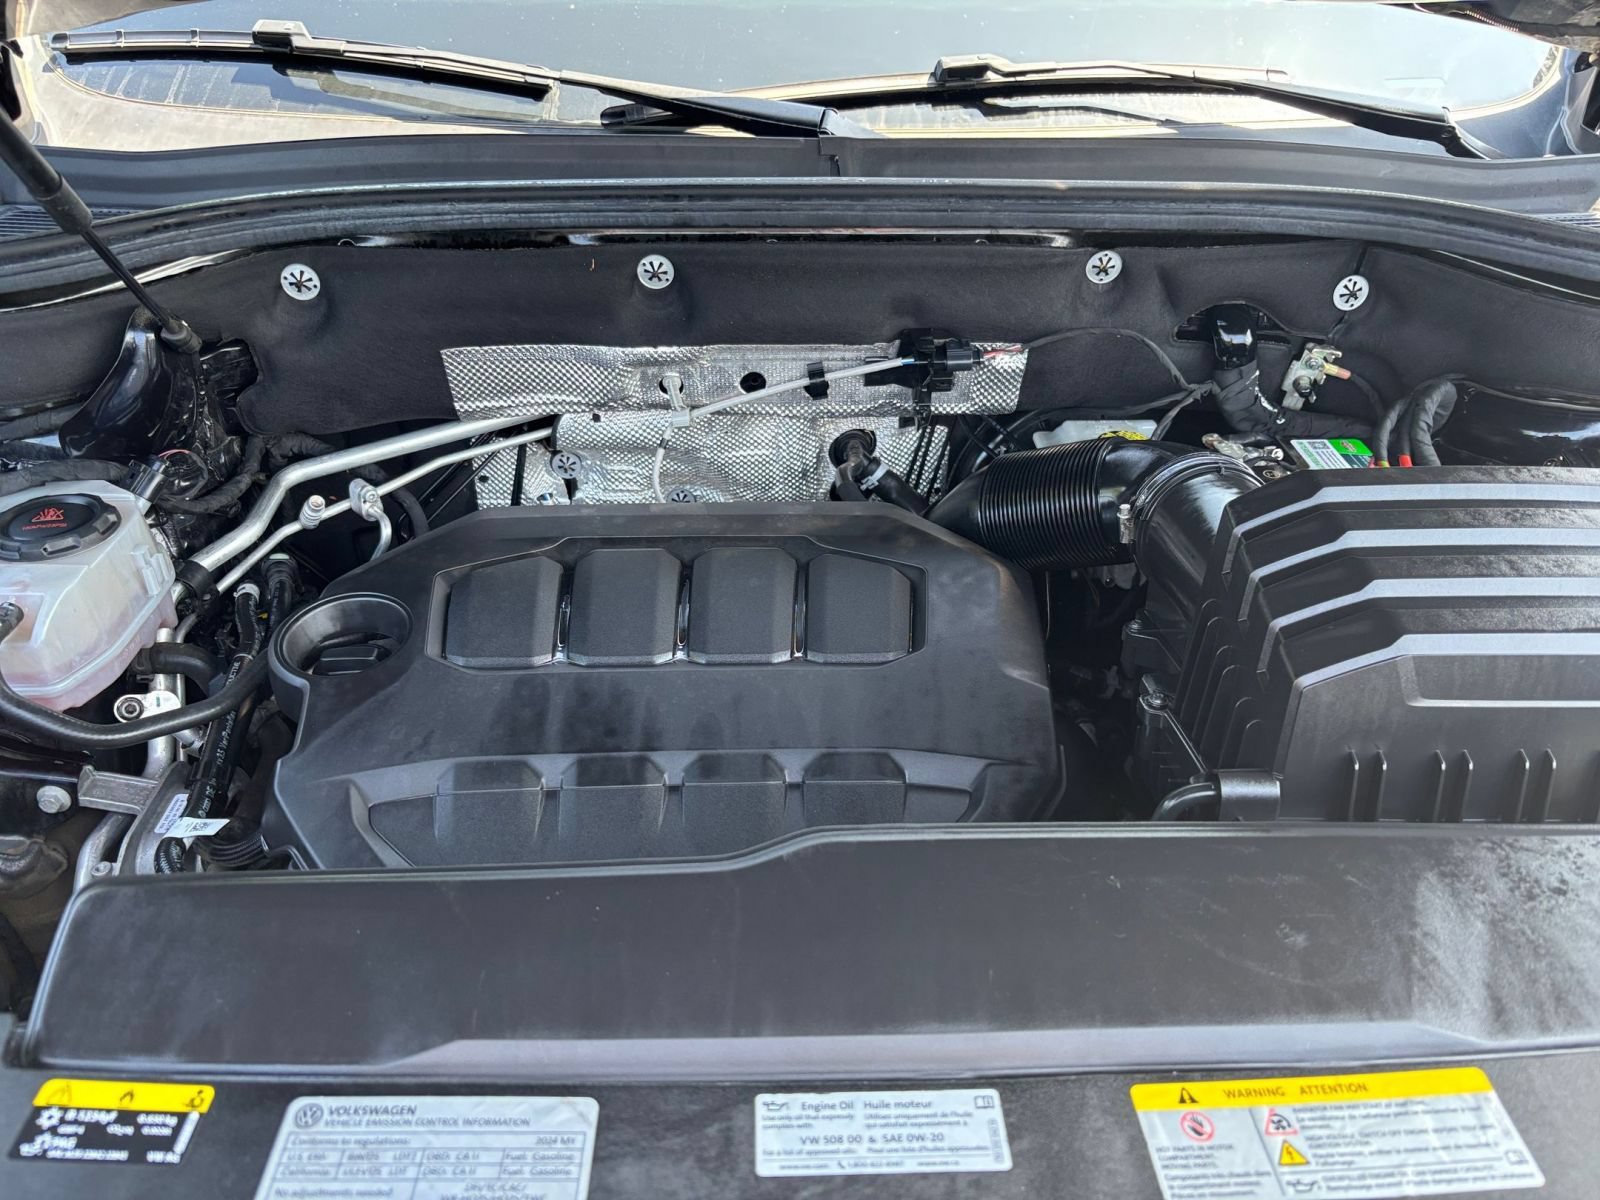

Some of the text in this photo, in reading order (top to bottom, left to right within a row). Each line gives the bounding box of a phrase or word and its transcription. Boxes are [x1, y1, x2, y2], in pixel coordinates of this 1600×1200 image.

[1224, 1082, 1368, 1099] WARNING ATTENTION
[328, 1104, 417, 1116] VOLKSWAGEN
[801, 1100, 853, 1112] Engine Oil
[864, 1100, 932, 1109] Huile moteur
[324, 1117, 531, 1127] VEHICLE EMISSION CONTROL INFORMATION
[536, 1136, 558, 1145] 2024
[800, 1135, 820, 1145] VW
[823, 1135, 844, 1144] 508
[847, 1134, 862, 1143] 00
[883, 1133, 903, 1143] SAE
[906, 1132, 944, 1142] 0W-20
